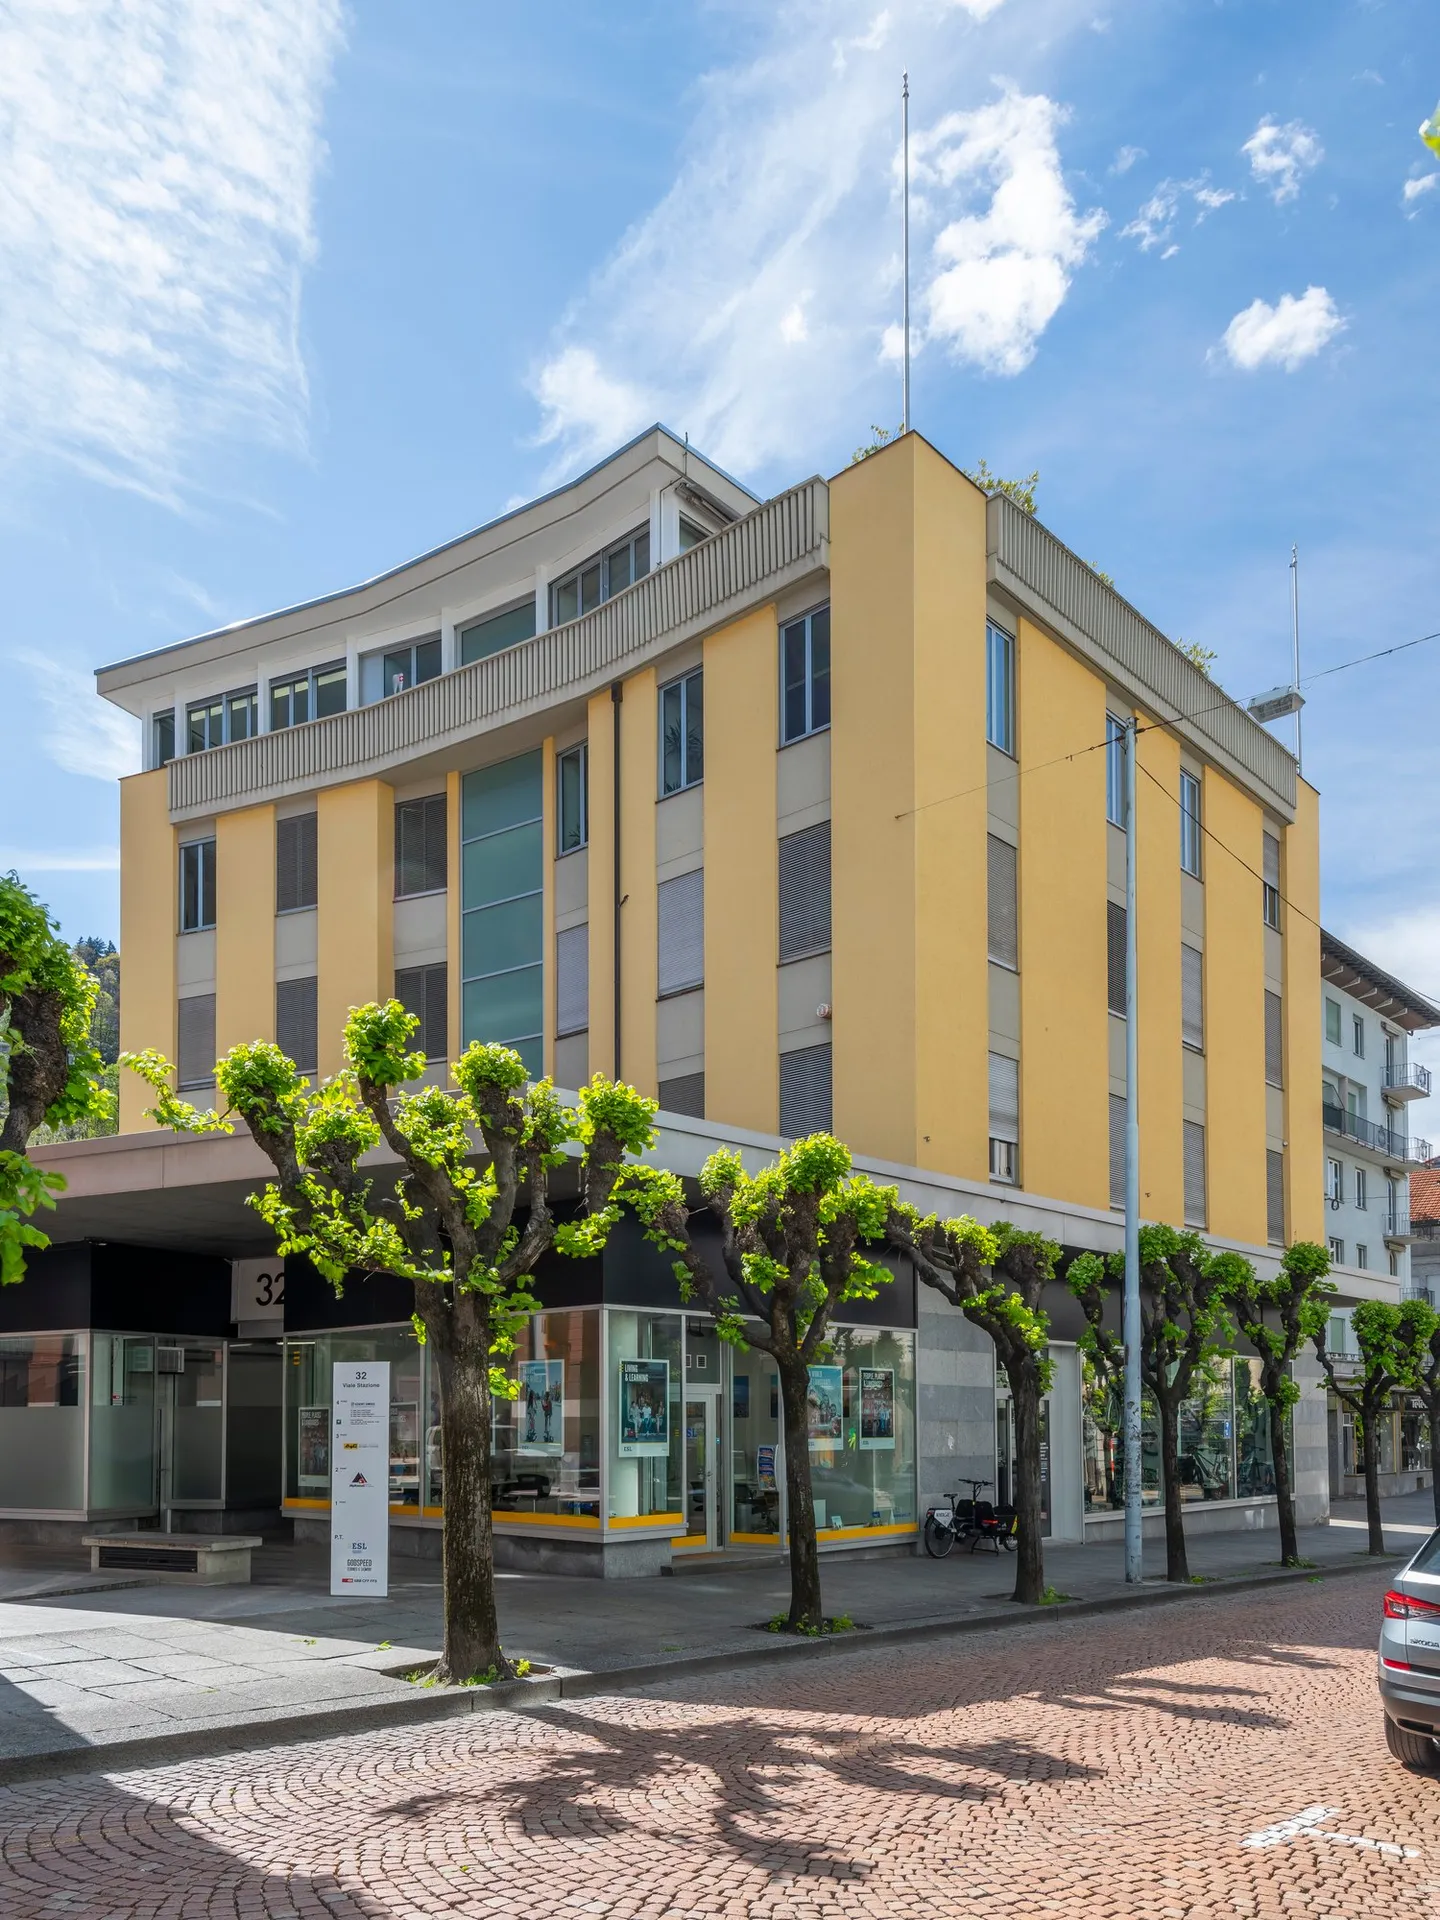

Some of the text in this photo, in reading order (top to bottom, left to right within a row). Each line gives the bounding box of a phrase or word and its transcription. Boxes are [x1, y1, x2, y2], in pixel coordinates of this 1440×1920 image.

[255, 1272, 284, 1306] 32
[625, 1364, 638, 1373] LIVING
[355, 1371, 367, 1380] 32
[629, 1373, 649, 1382] LEARNING
[352, 1542, 367, 1550] ESL
[346, 1558, 372, 1567] GODSPEED
